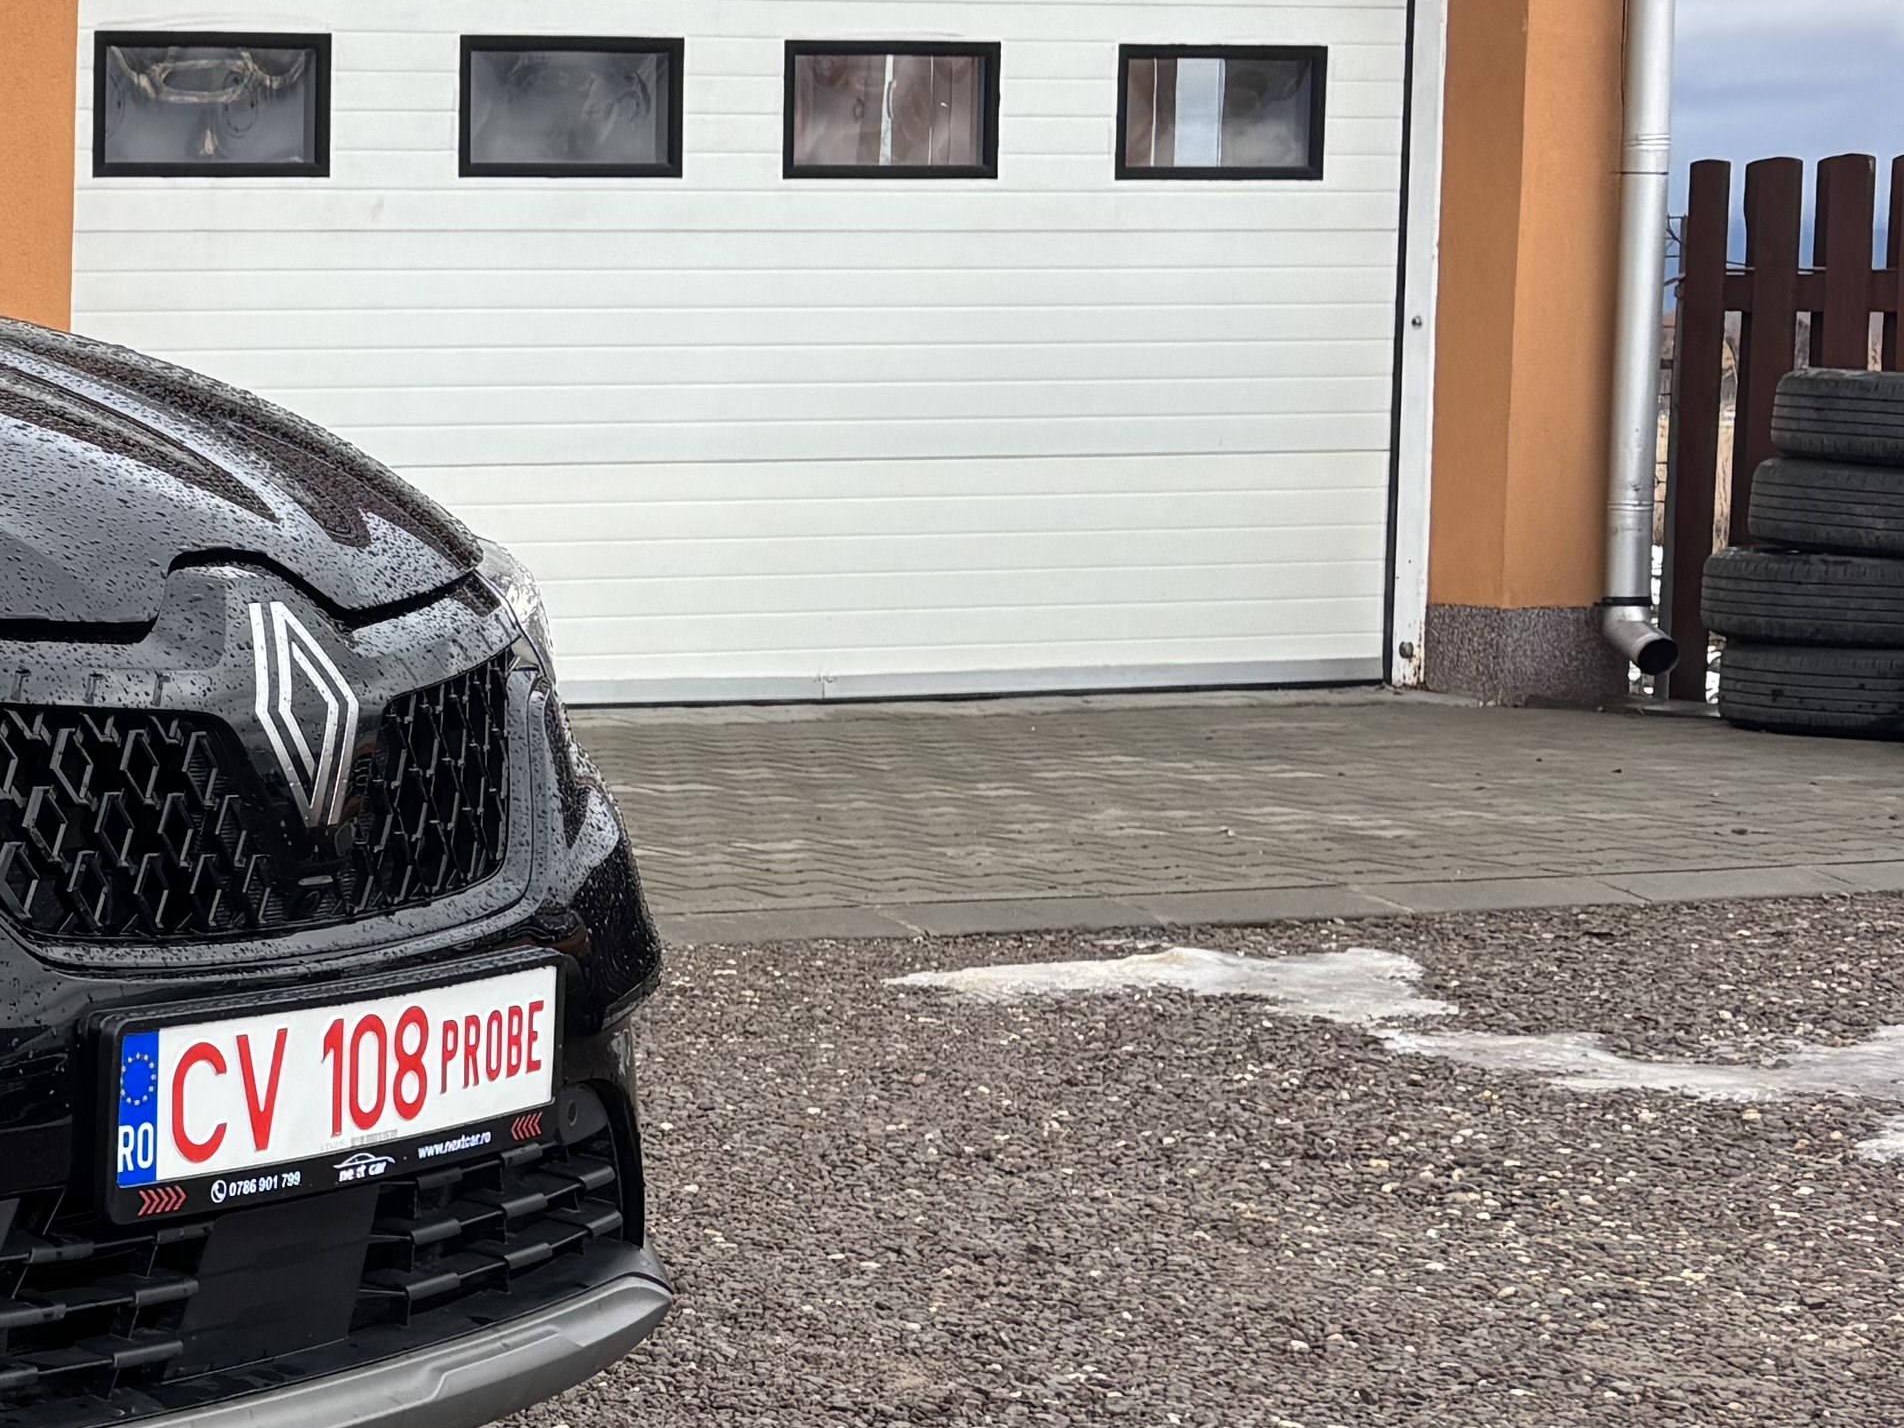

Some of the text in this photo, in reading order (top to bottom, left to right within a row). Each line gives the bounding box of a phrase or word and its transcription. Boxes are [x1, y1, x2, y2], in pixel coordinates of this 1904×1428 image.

[171, 999, 545, 1163] CV 108 PROBE
[117, 1121, 155, 1172] RO
[228, 1171, 301, 1197] 0786 901 799
